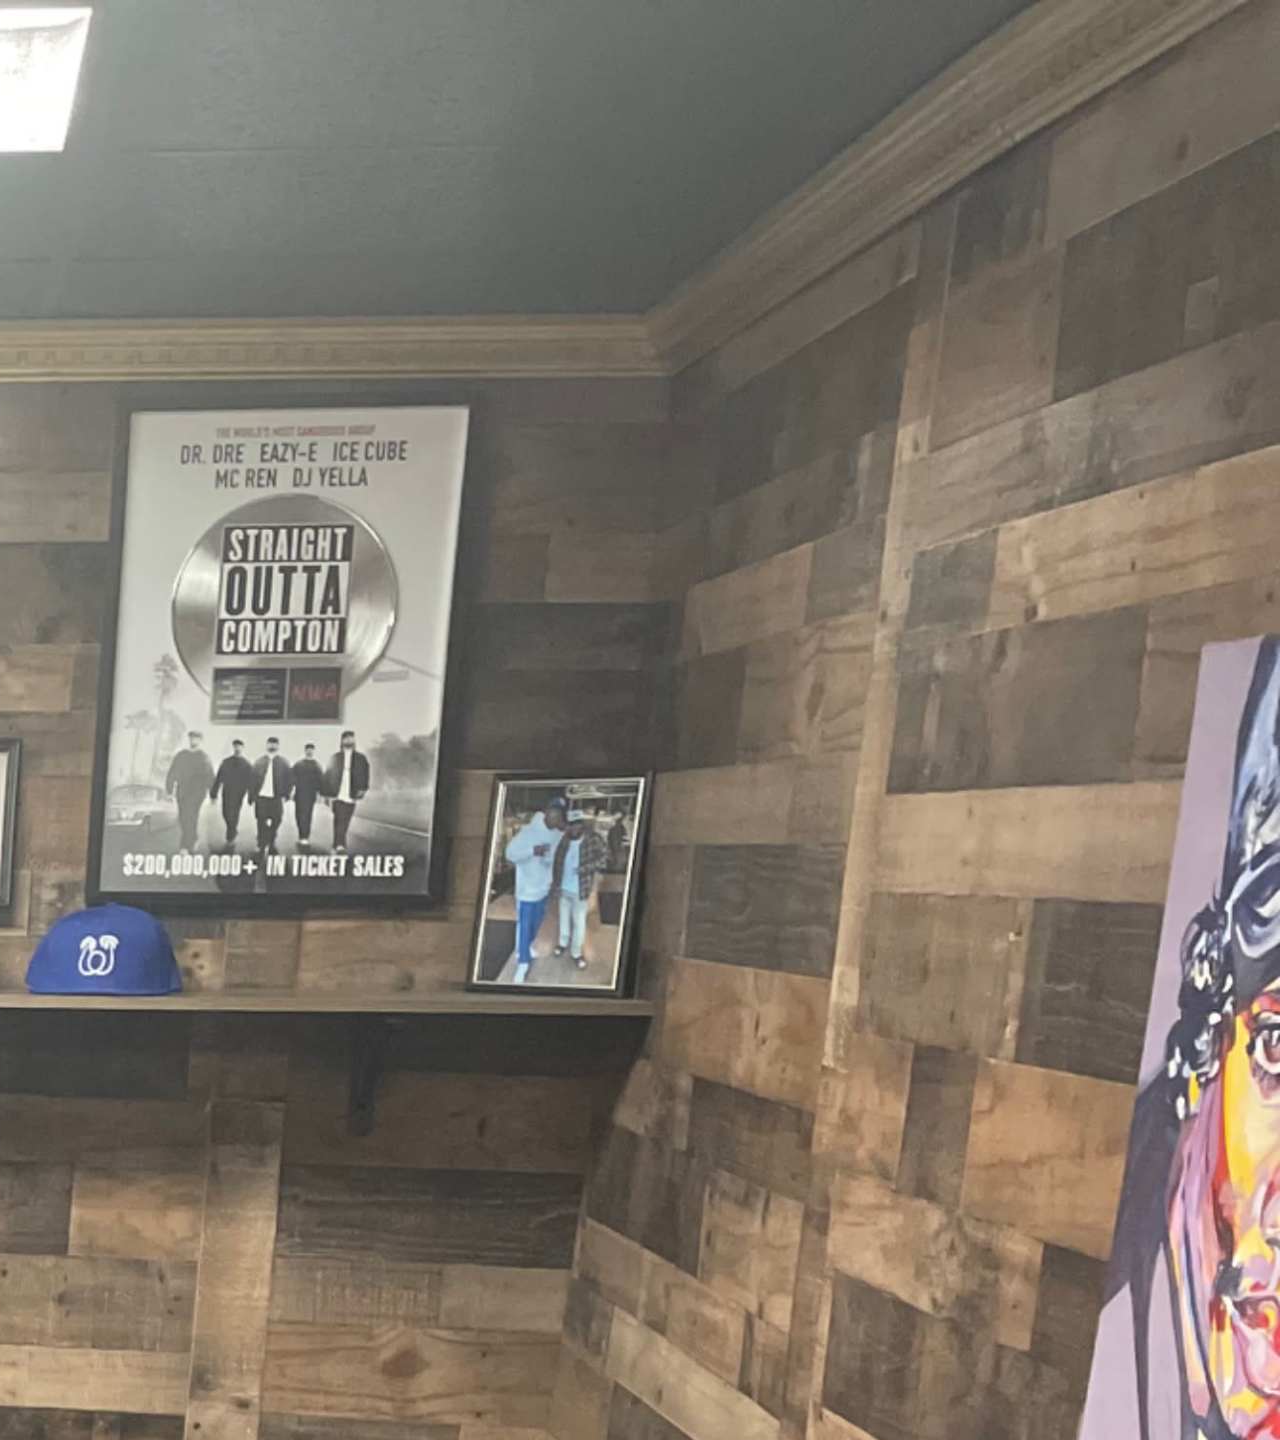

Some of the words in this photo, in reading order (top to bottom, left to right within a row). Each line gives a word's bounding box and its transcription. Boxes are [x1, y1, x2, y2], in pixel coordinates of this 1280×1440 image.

[180, 444, 207, 464] DR.
[212, 443, 245, 463] DRE
[259, 442, 319, 463] EAZY-E
[332, 441, 360, 462] ICE
[364, 440, 408, 461] CUBE
[214, 469, 240, 488] MC
[244, 468, 278, 488] REN
[292, 467, 312, 487] DJ
[318, 466, 369, 487] YELLA
[228, 527, 347, 562] STRAIGHT
[224, 564, 341, 616] OUTTA
[221, 619, 340, 652] COMPTON
[122, 853, 258, 879] $200,000,000+
[265, 855, 285, 877] IN
[291, 854, 348, 877] TICKET
[352, 855, 405, 877] SALES
